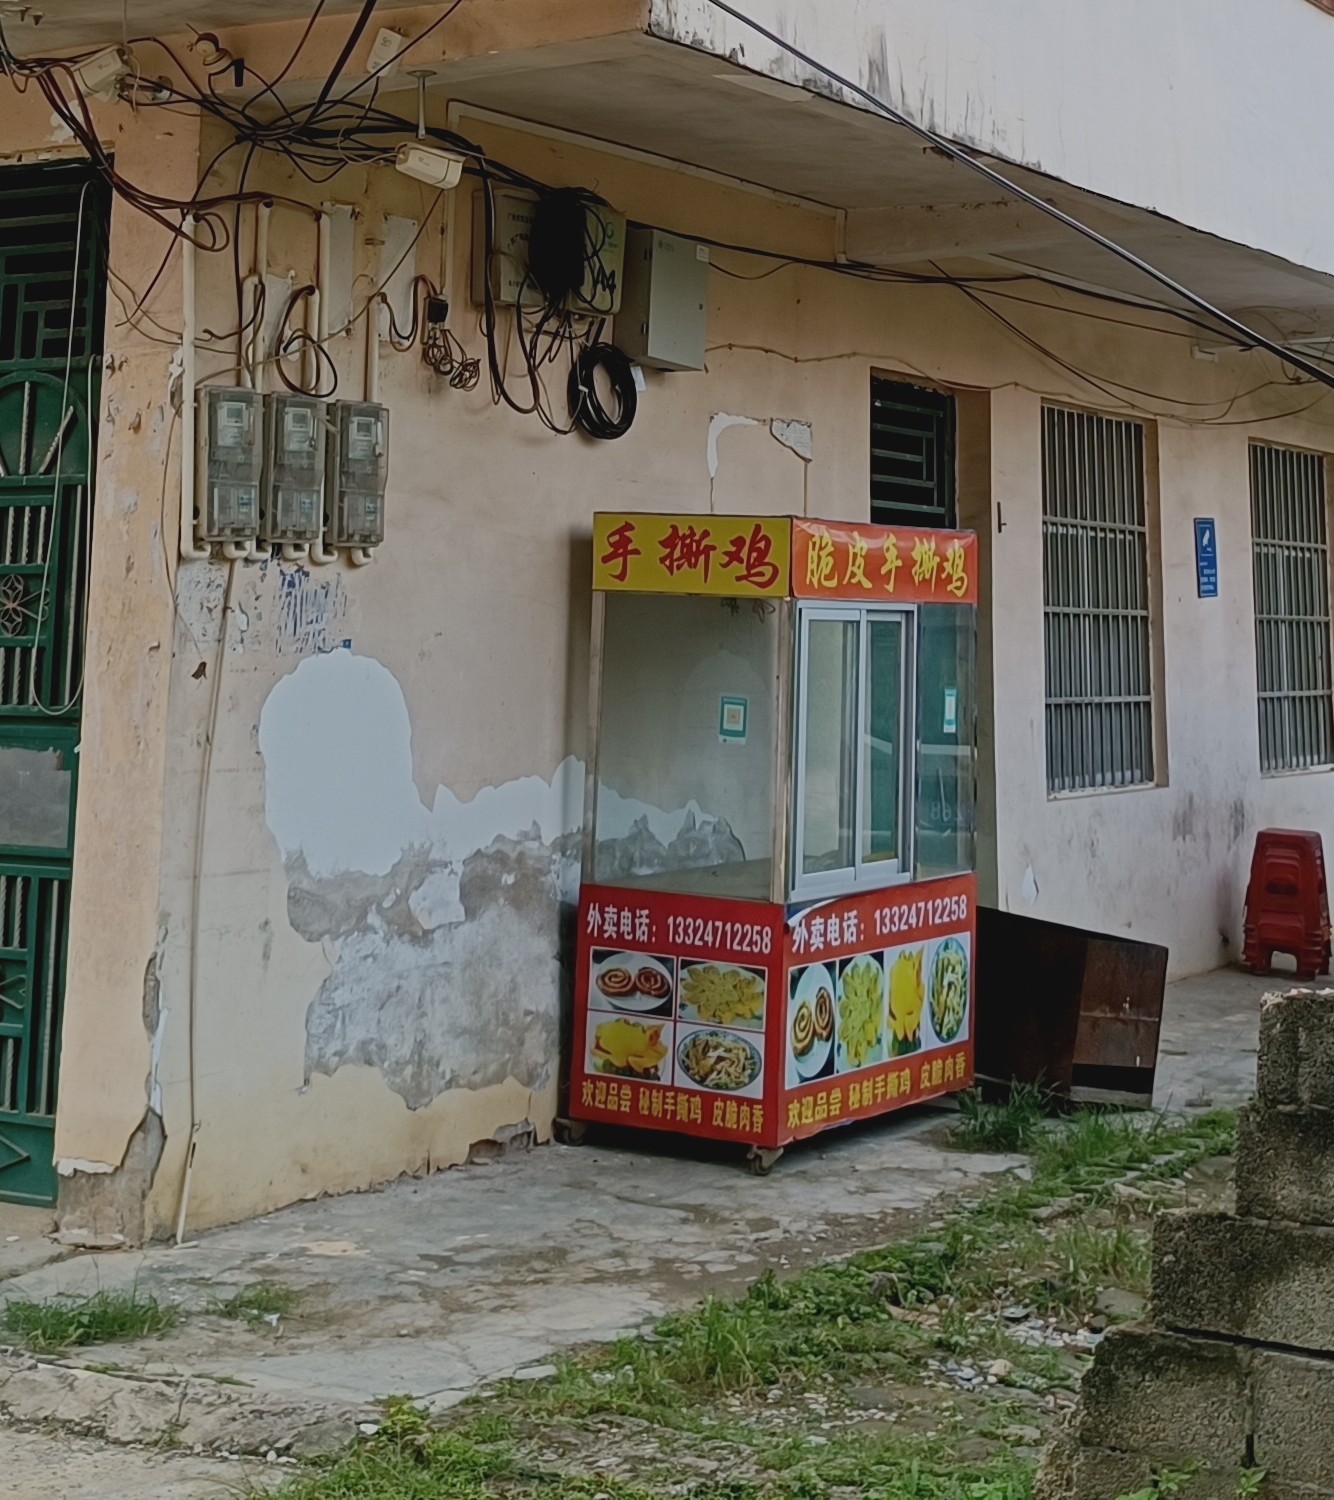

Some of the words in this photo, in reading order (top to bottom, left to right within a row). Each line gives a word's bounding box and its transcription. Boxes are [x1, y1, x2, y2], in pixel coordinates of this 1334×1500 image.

[600, 520, 779, 589] 手撕鸡
[806, 531, 969, 598] 脆皮手撕鸡
[667, 915, 772, 954] 13324712258
[874, 894, 967, 935] 13324712258
[581, 1079, 632, 1113] 欢迎品尝
[638, 1086, 702, 1124] 秘制手撕鸡
[711, 1097, 764, 1133] 皮脆肉香
[787, 1088, 842, 1129] 欢迎品尝
[848, 1067, 911, 1111] 秘制手撕鸡
[920, 1051, 966, 1089] 皮脆肉香
